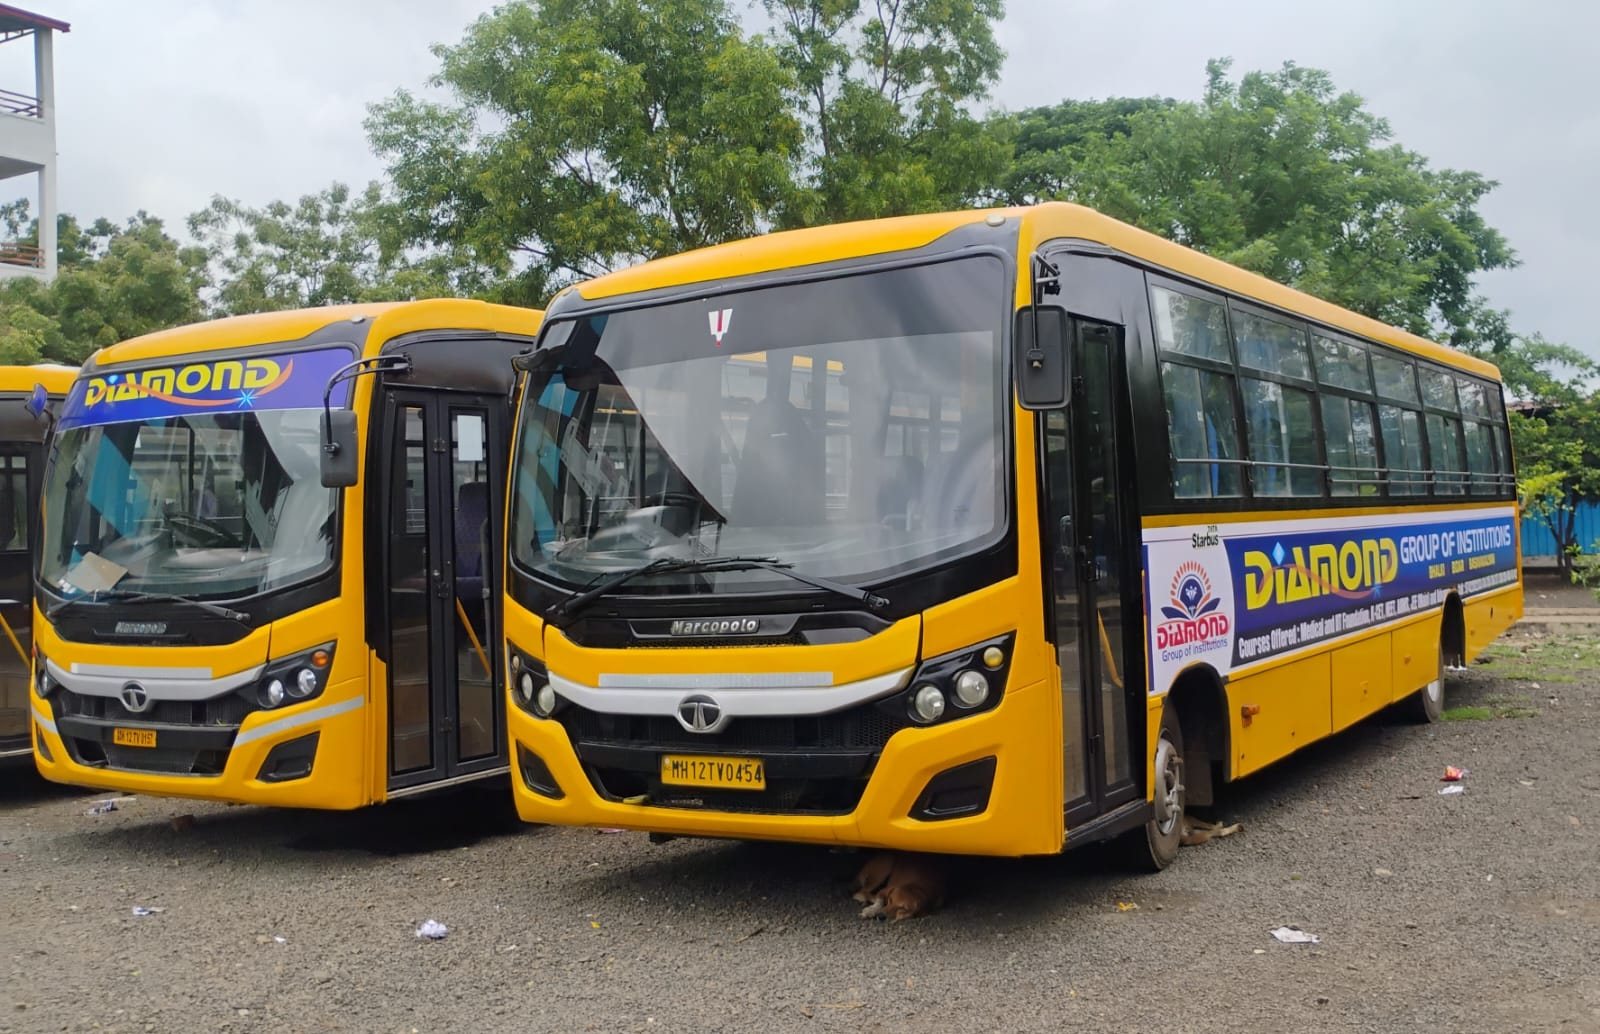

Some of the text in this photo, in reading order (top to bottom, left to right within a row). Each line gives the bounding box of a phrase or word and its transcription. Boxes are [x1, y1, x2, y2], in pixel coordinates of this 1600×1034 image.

[1192, 532, 1219, 548] Starbus
[1400, 533, 1439, 564] GROUP
[1441, 531, 1456, 557] OF
[1456, 524, 1511, 554] INSTITUTIONS
[671, 619, 757, 634] Marcopolo
[1239, 634, 1270, 659] Courses
[1271, 625, 1296, 650] Offered
[1300, 617, 1324, 642] Medical
[1162, 648, 1183, 662] Group
[1184, 644, 1192, 657] of
[671, 759, 763, 783] MH12TV0454
